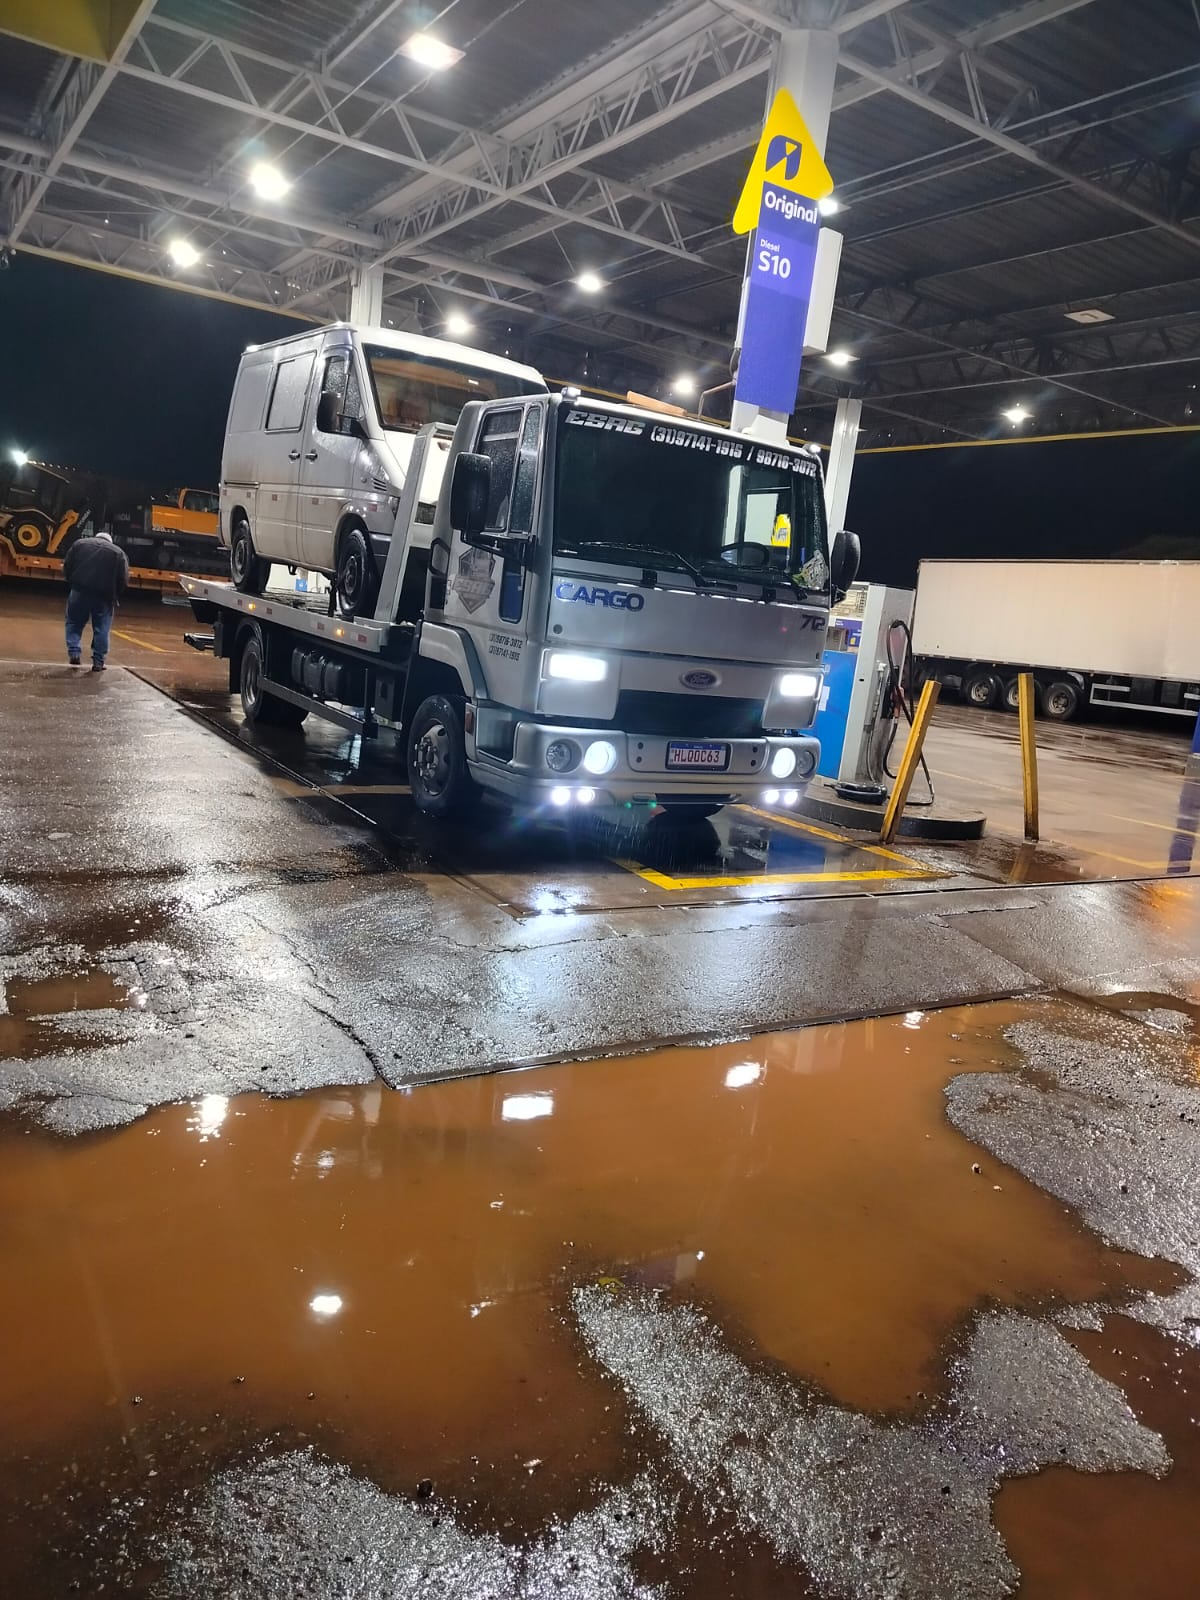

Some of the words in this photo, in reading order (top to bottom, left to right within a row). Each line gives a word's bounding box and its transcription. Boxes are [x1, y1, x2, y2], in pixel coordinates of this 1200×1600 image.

[765, 191, 817, 224] Original
[760, 238, 781, 253] Diesel
[757, 250, 791, 279] S10
[555, 582, 645, 612] CARGO
